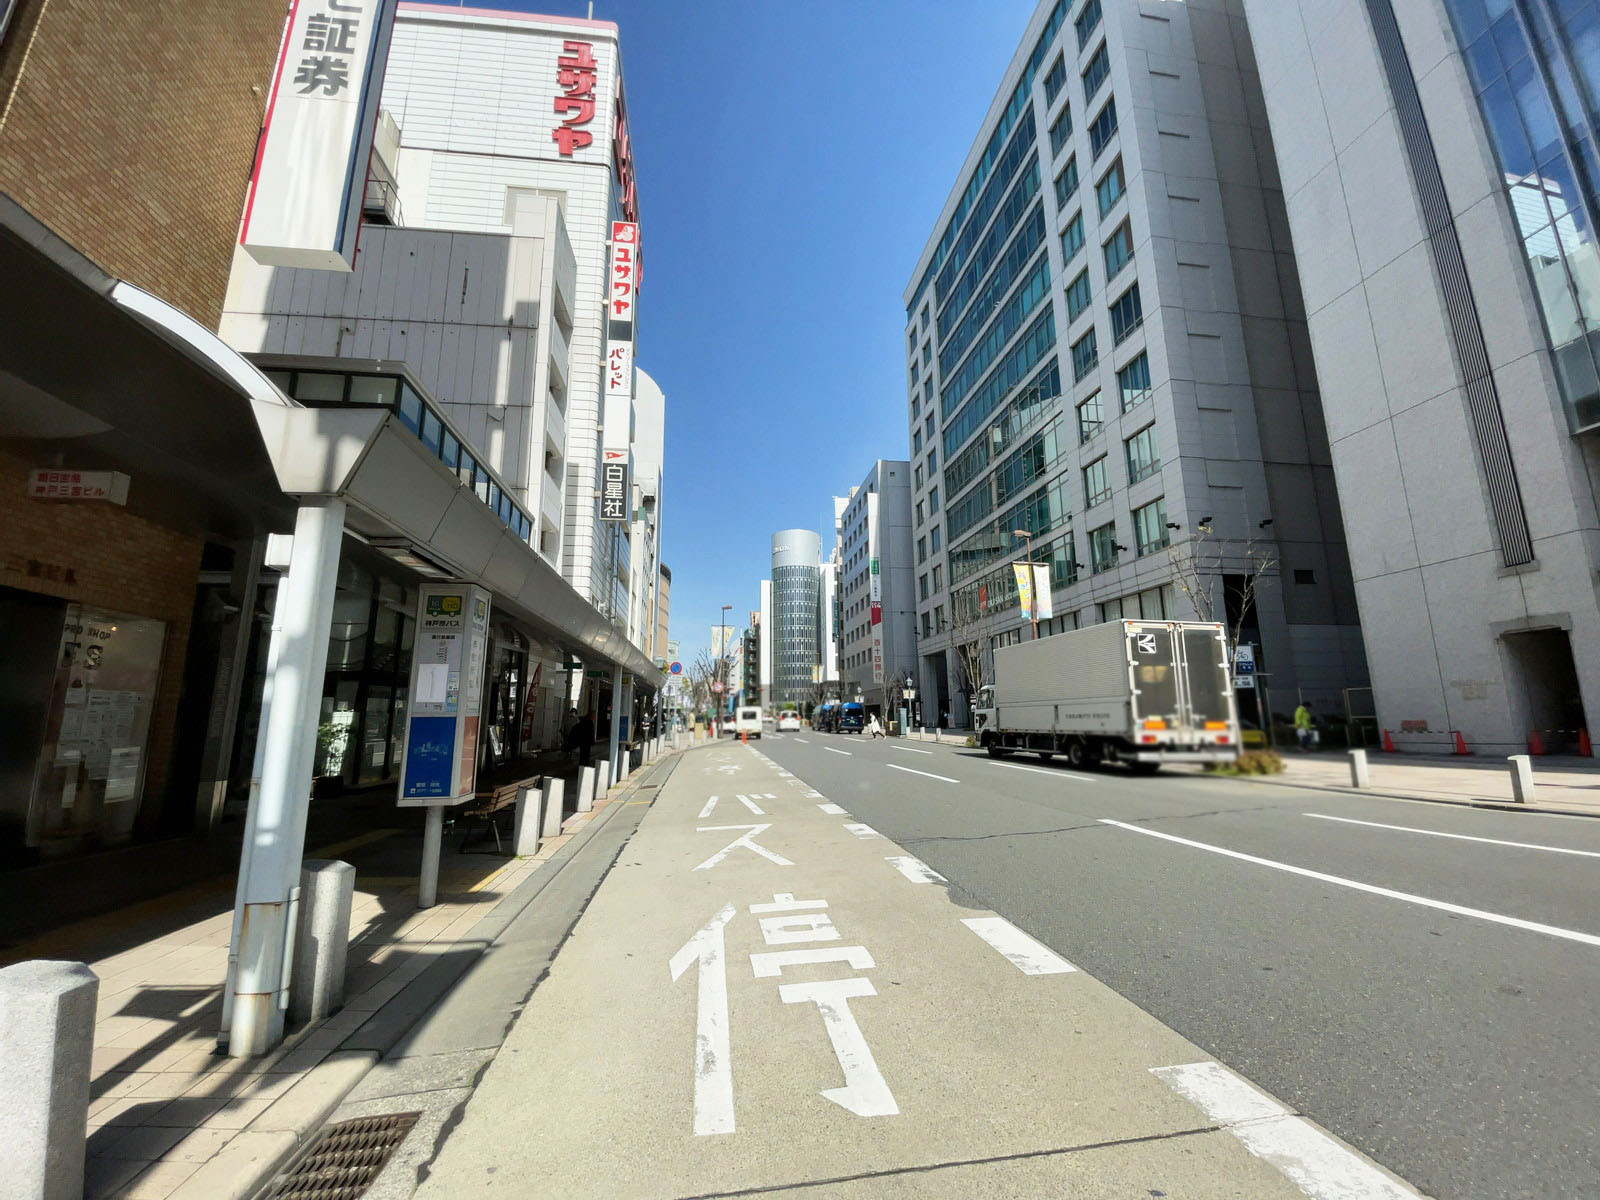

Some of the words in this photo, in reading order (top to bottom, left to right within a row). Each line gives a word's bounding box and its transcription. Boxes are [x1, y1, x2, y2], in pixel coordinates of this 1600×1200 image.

[293, 0, 363, 96] 証券
[552, 40, 597, 156] ユザワヤ
[608, 347, 625, 389] パレット
[603, 464, 624, 517] 白星社
[874, 639, 882, 681] 百十四銀行
